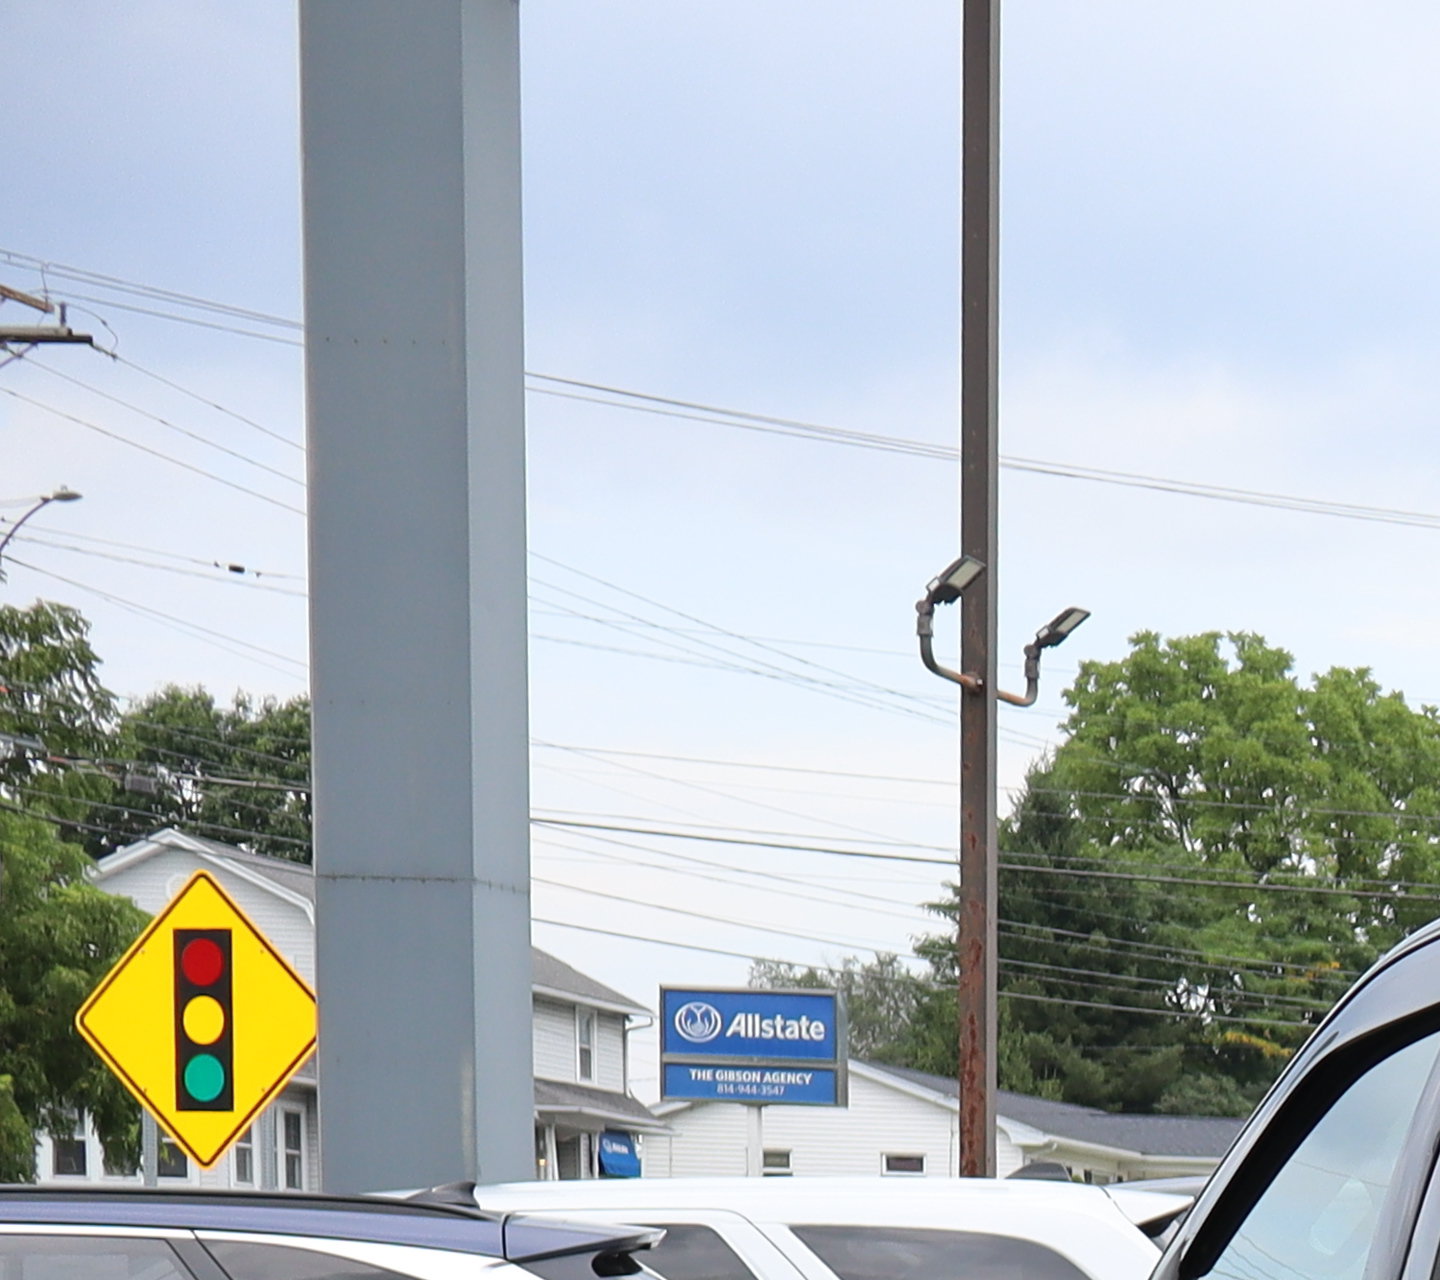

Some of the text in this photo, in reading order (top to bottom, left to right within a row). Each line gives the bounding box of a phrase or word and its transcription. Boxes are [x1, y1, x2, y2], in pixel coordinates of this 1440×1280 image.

[725, 1012, 825, 1041] Allstate
[689, 1068, 813, 1085] THE GIBSON AGENCY
